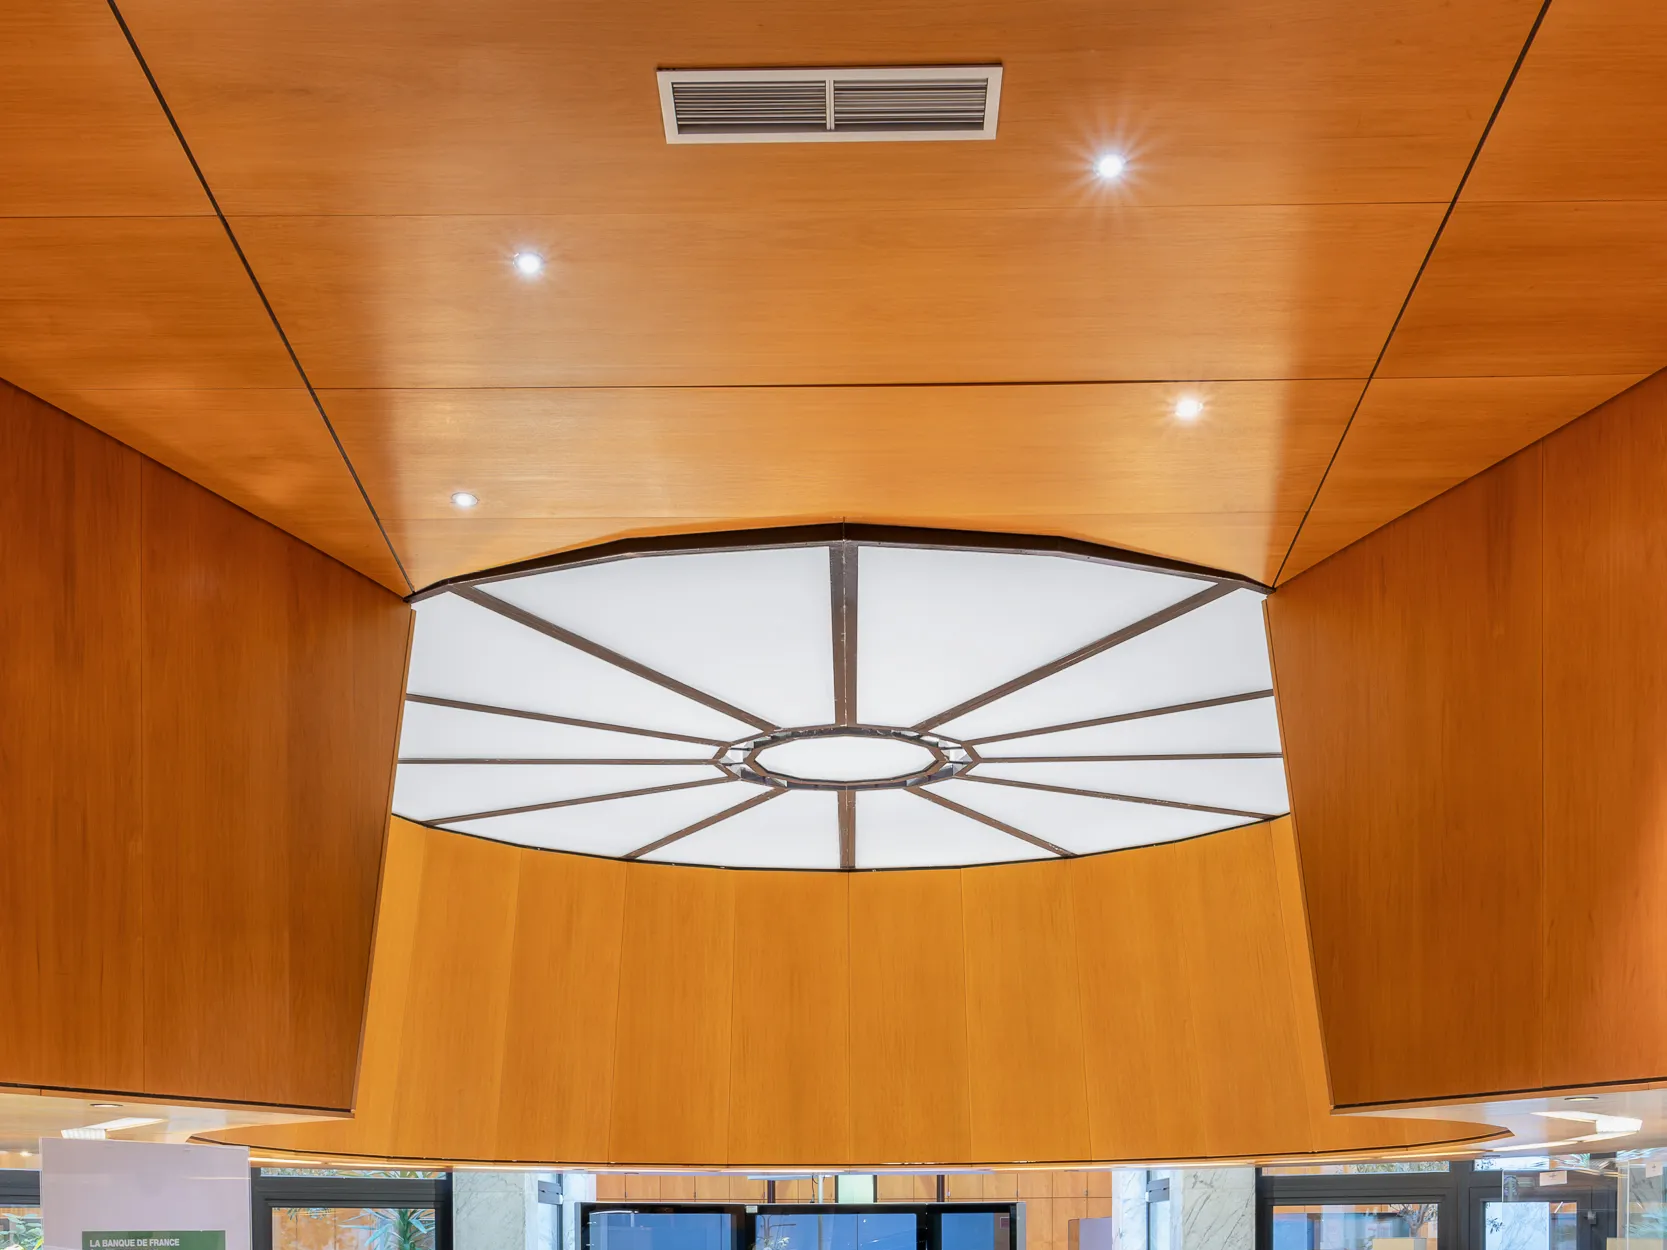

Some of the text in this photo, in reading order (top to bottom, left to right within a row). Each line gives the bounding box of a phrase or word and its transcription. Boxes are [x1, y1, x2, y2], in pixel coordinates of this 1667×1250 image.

[89, 1238, 180, 1248] LA BANQUE DE FRANCE
